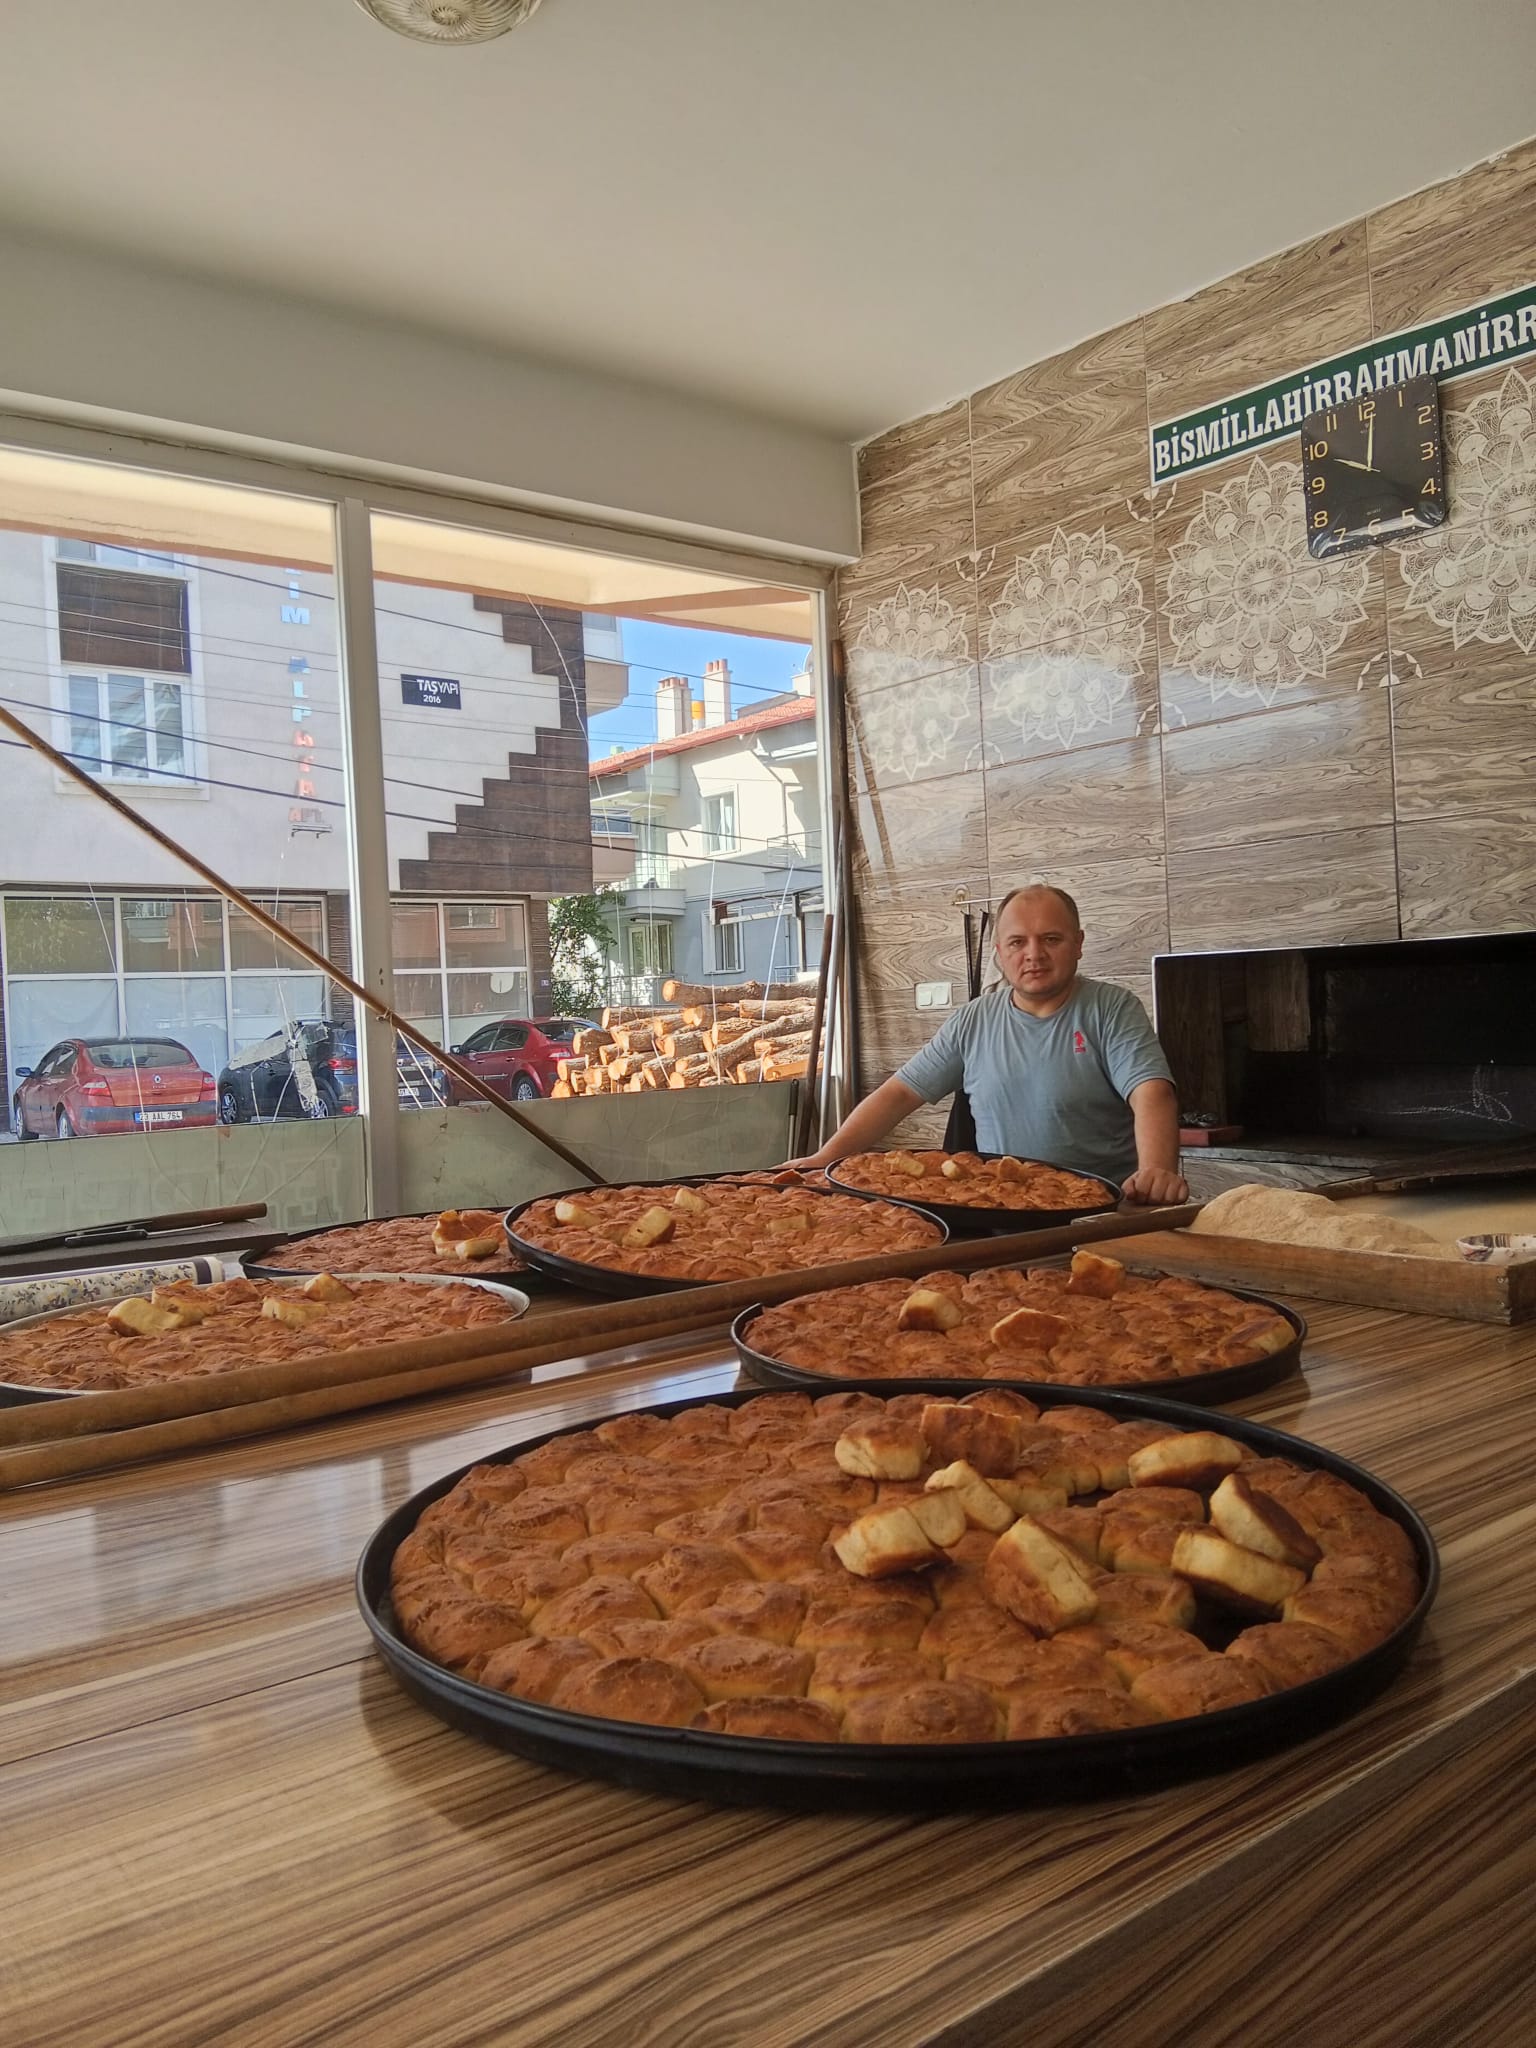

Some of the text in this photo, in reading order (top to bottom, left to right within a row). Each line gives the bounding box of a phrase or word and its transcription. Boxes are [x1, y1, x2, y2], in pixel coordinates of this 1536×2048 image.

[1398, 390, 1403, 408] 1
[1358, 400, 1377, 422] 12
[1417, 405, 1432, 425] 2
[1326, 413, 1337, 433] 11
[1309, 440, 1328, 461] 10
[1420, 441, 1434, 461] 3
[1311, 476, 1325, 495] 9
[1421, 477, 1437, 495] 4
[1313, 510, 1328, 528] 8
[1402, 507, 1417, 526] 5
[1333, 527, 1346, 544] 7
[1367, 518, 1381, 537] 6
[423, 694, 441, 705] 2016
